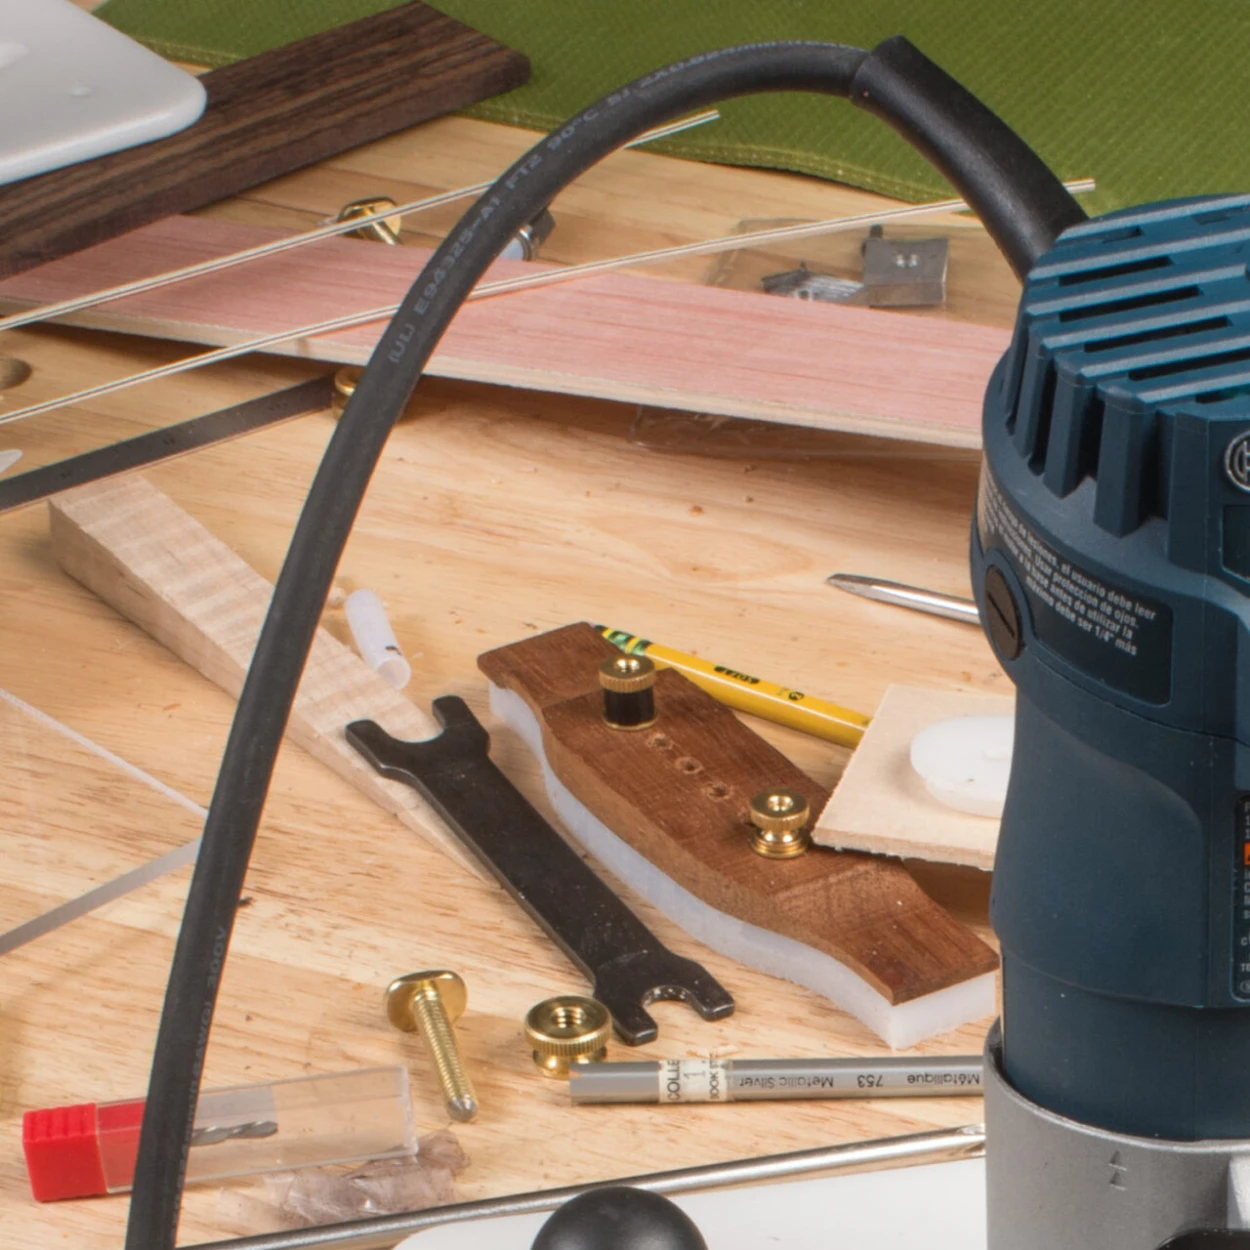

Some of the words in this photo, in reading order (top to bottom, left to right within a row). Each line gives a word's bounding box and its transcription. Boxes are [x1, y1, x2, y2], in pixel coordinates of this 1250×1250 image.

[1107, 590, 1133, 611] debe
[1134, 602, 1156, 621] leer
[1077, 616, 1093, 633] ser
[738, 1075, 776, 1088] Silver
[779, 1075, 834, 1088] Metallic
[856, 1073, 884, 1088] 753
[906, 1071, 981, 1087] Métallique
